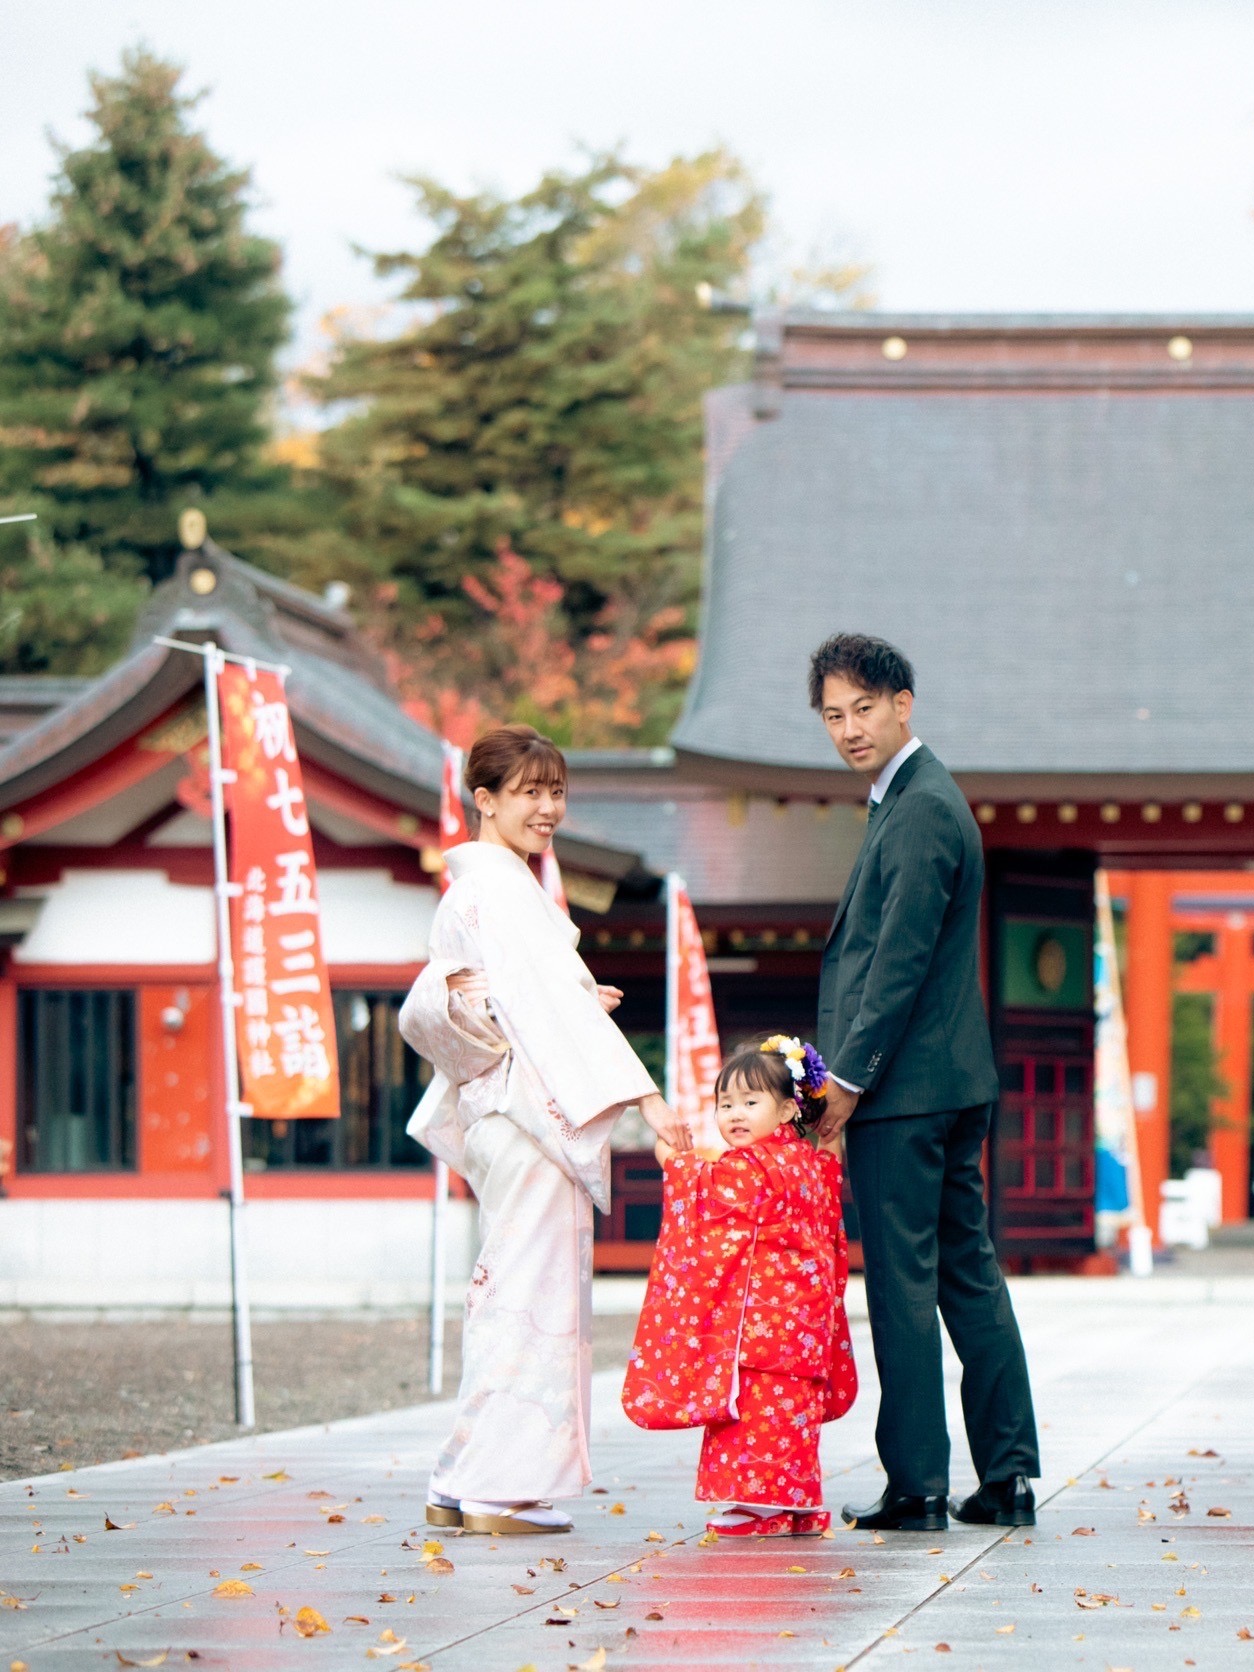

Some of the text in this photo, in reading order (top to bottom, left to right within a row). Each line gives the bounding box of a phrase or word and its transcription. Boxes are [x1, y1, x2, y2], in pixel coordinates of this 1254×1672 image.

[251, 693, 330, 1080] 祝七五三詣
